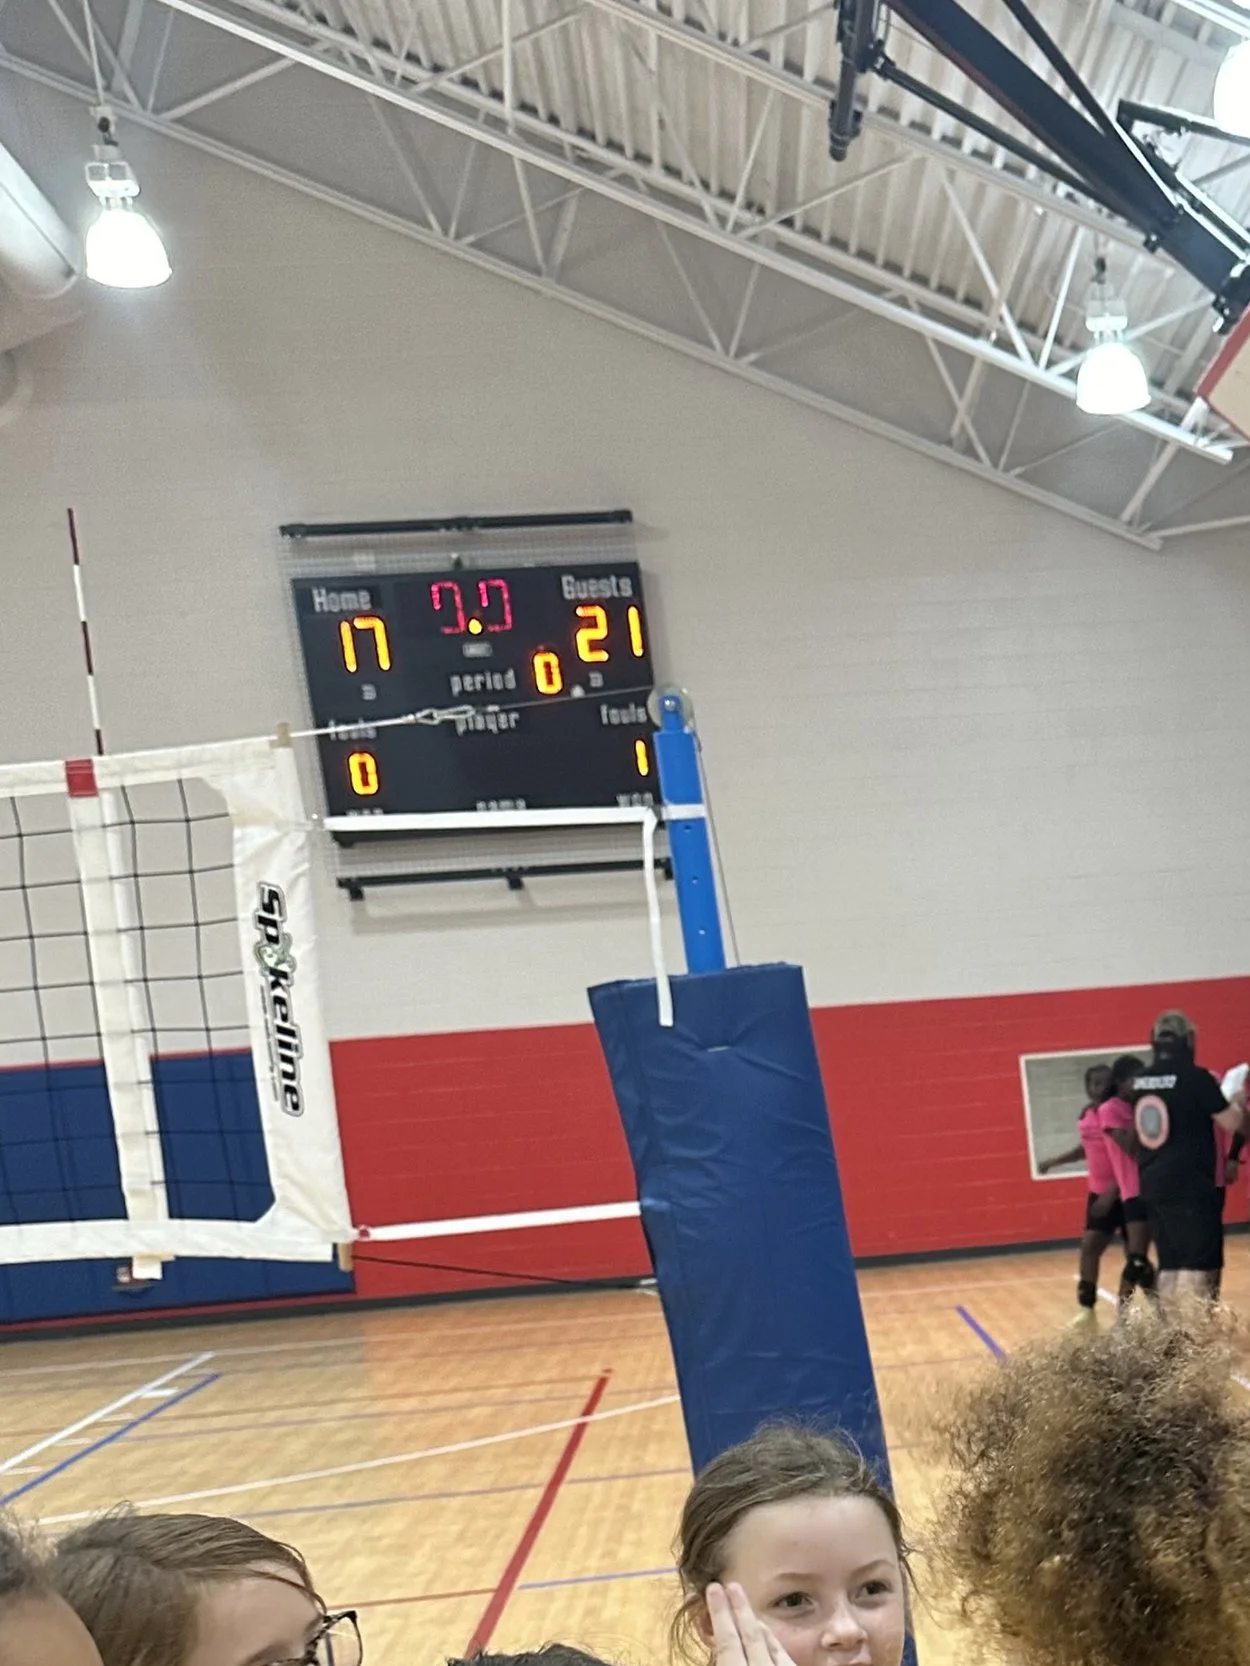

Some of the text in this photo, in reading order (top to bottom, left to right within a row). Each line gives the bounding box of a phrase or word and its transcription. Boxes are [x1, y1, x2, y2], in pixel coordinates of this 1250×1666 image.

[312, 587, 372, 613] Home
[561, 574, 633, 600] Guests
[340, 616, 391, 673] 17
[575, 604, 644, 663] 21
[450, 667, 516, 697] period
[533, 652, 563, 695] 0
[600, 702, 647, 726] fouls
[348, 751, 379, 796] 0
[635, 739, 649, 777] 1
